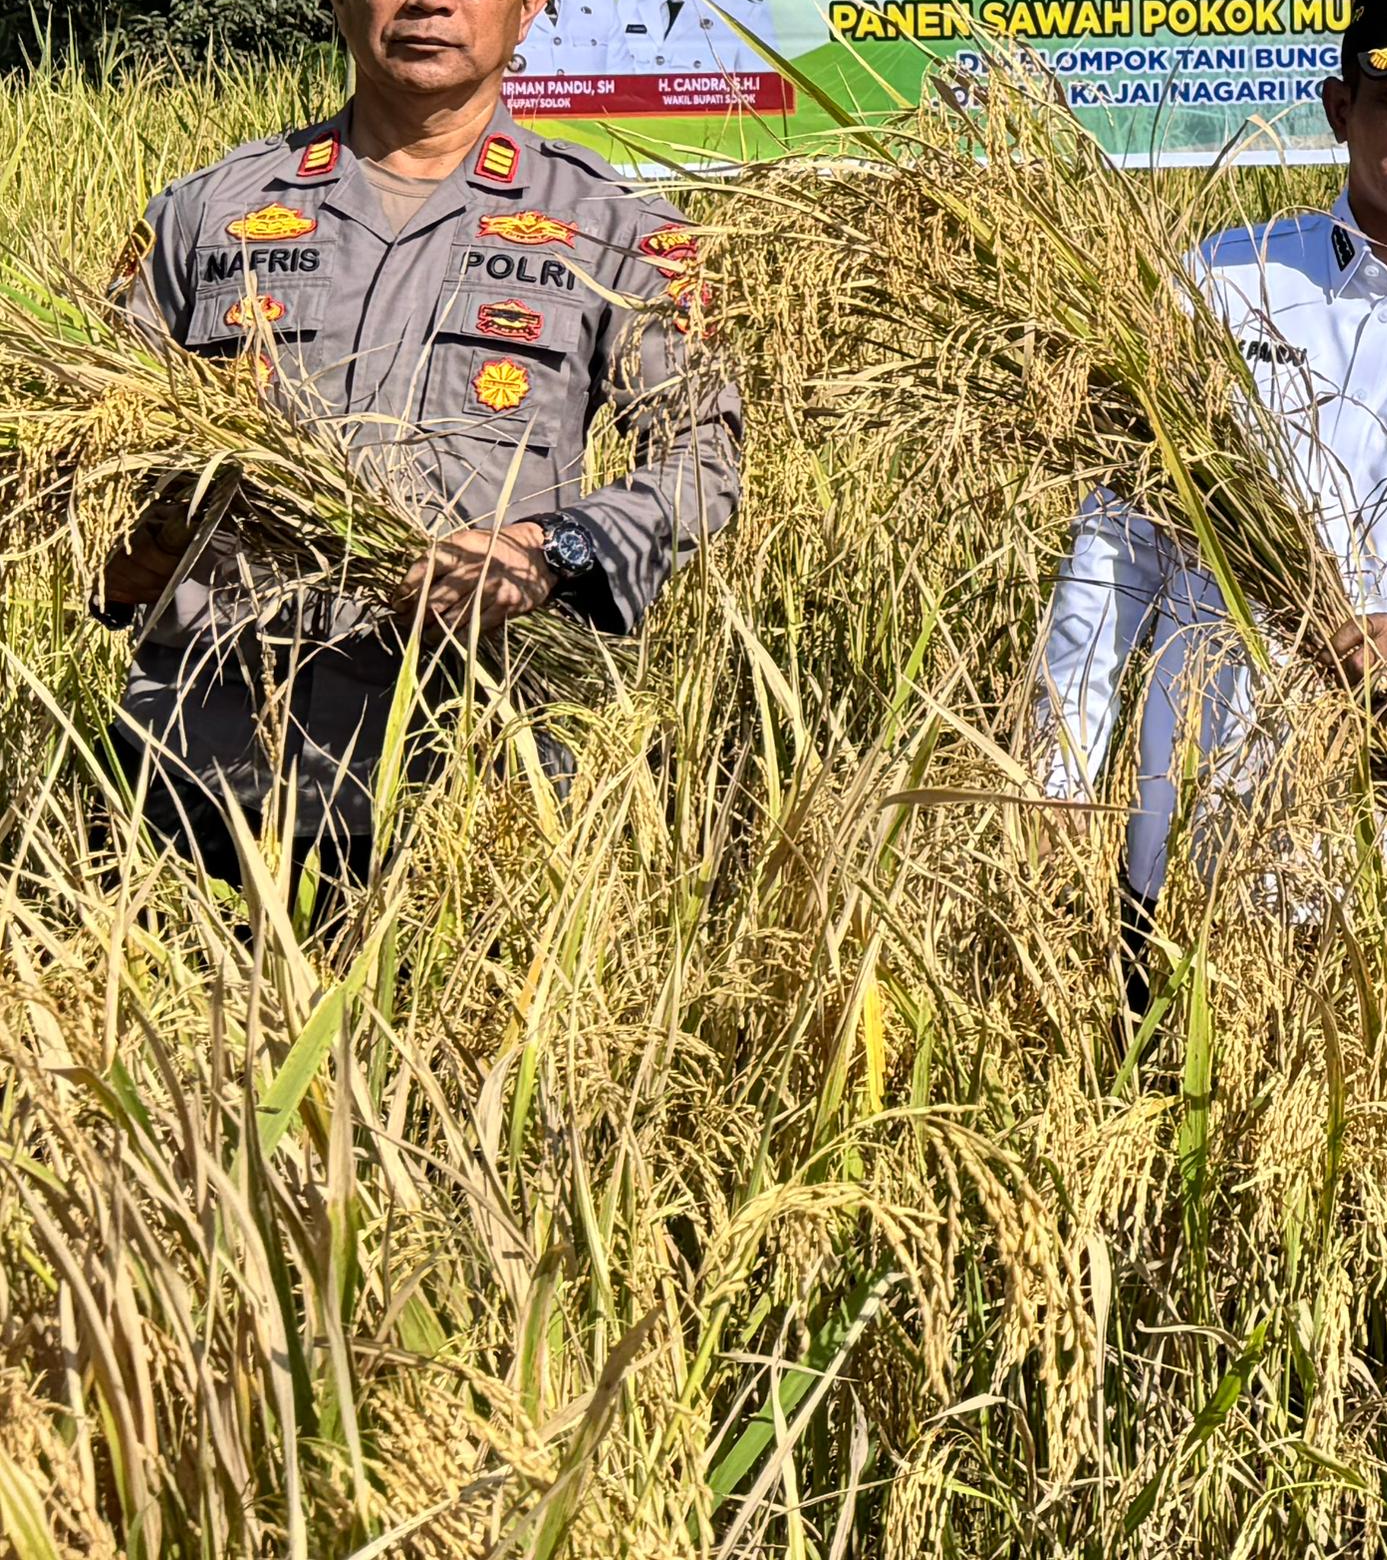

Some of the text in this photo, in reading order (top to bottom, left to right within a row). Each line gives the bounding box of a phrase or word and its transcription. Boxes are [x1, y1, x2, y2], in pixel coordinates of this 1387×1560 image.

[830, 0, 973, 40] PANEN
[1178, 46, 1246, 71] TANI
[547, 79, 595, 96] PANDU,
[597, 79, 615, 94] SH
[658, 77, 672, 92] H.
[673, 77, 731, 93] CANDRA,
[1070, 81, 1160, 106] KAJAI
[1169, 79, 1285, 104] NAGARI
[539, 97, 571, 108] SOLOK
[662, 95, 692, 105] WAKIL
[693, 94, 723, 105] BUPATI
[204, 247, 320, 282] NAFRIS
[462, 250, 576, 291] POLRI
